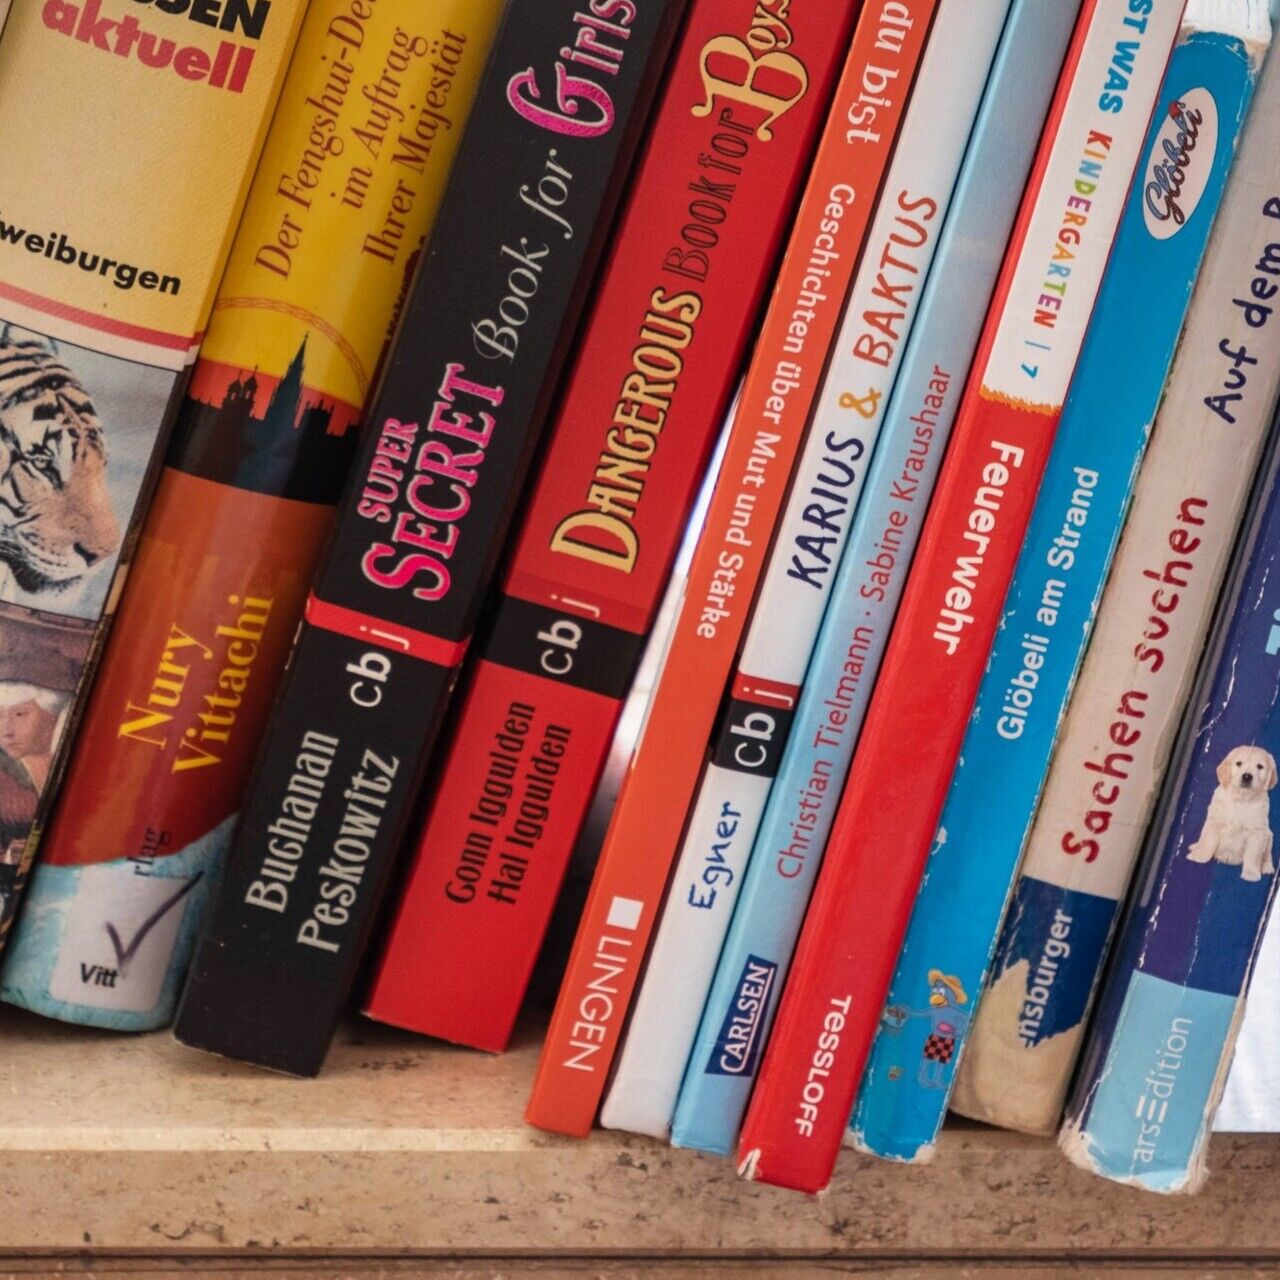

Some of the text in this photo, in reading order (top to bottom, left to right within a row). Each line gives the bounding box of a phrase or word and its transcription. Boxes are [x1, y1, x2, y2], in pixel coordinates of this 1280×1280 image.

[846, 61, 901, 145] bist
[875, 0, 915, 53] du
[1098, 40, 1140, 114] WAS
[330, 27, 429, 210] im Auftrag
[362, 27, 467, 266] Ihrer Majestät
[520, 148, 574, 239] for
[255, 213, 303, 281] Der
[1032, 129, 1113, 329] KINDERGARTEN
[357, 417, 418, 523] SUPER
[549, 286, 703, 574] DANGEROUS
[697, 183, 856, 640] Geschichten über Mut und Stärke
[786, 189, 938, 588] KARIUS BAKTUS
[1204, 339, 1259, 424] Auf
[361, 362, 504, 601] SECRET
[933, 441, 1025, 656] Feuerwehr
[1035, 466, 1100, 626] am Strand
[118, 623, 213, 749] Nury
[172, 594, 274, 774] Vittachi
[777, 365, 953, 879] Christian Tielmann Sabine Kraushaar
[1060, 496, 1208, 863] Sachen suchen
[244, 730, 339, 913] Buchanan
[297, 748, 399, 954] Peskowitz
[471, 700, 536, 825] Iggulden
[487, 723, 571, 905] Hal Iggulden
[688, 801, 741, 910] Egner
[564, 936, 632, 1072] LINGEN
